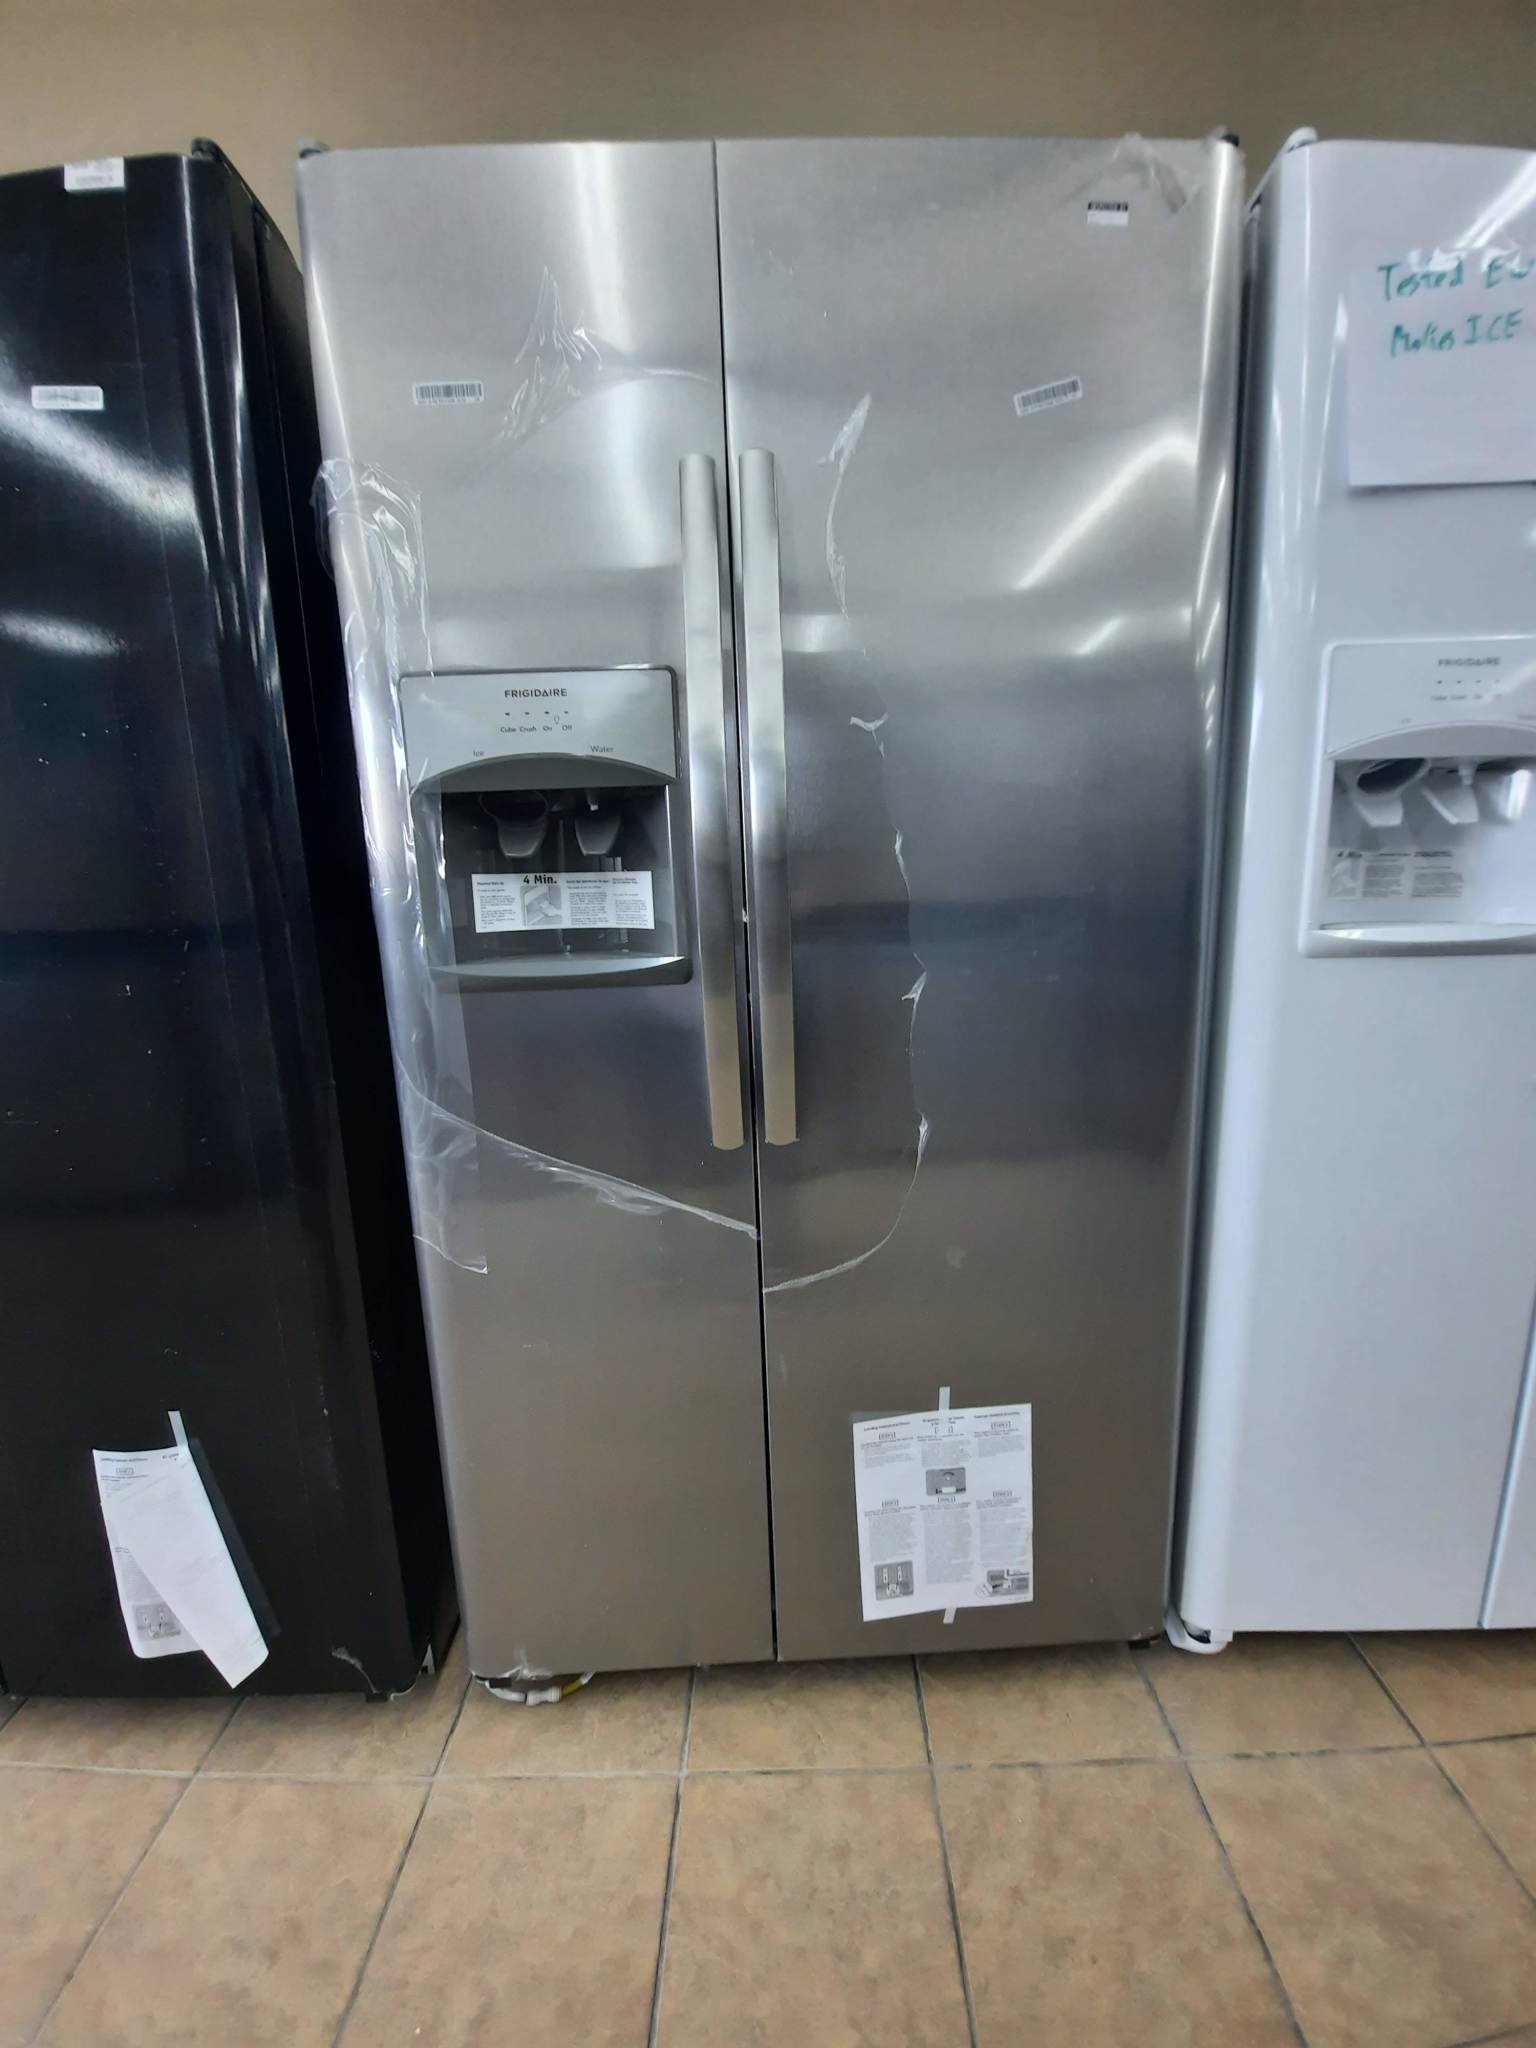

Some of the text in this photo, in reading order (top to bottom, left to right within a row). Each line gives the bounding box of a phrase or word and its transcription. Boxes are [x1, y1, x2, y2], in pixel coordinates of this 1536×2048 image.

[1377, 256, 1464, 302] Tested
[1464, 308, 1523, 345] ICE
[504, 688, 567, 698] FRIGIDAIRE
[473, 749, 485, 757] Ice
[590, 744, 615, 753] Water
[523, 874, 557, 884] 4 Min.
